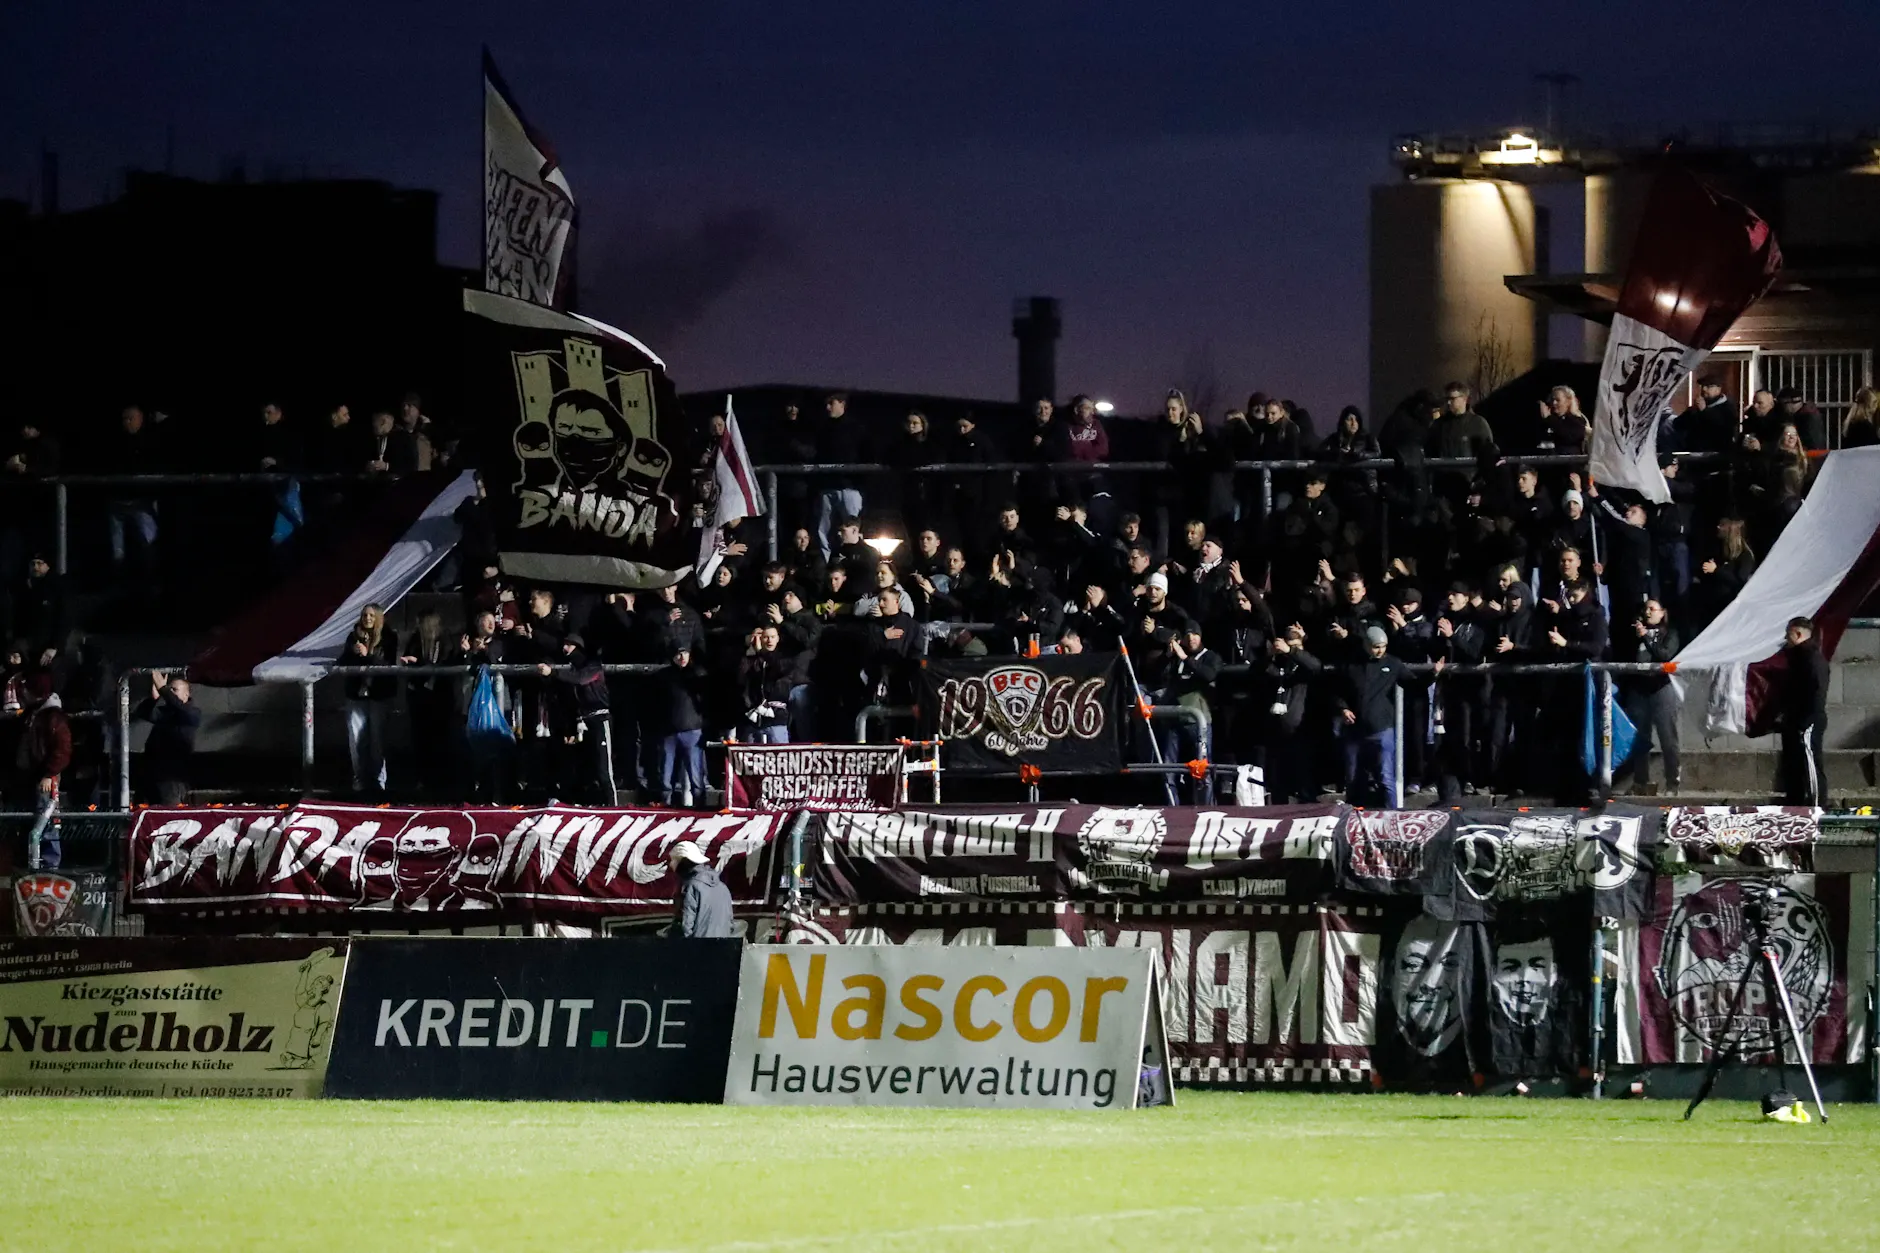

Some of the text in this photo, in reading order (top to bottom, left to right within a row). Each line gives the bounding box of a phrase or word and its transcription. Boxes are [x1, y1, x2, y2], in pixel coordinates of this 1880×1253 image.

[517, 489, 657, 548] BANDA
[992, 672, 1039, 692] BFC
[986, 731, 1047, 754] 60 Jahre
[733, 750, 898, 775] VERBANDSSTRAFEN
[761, 775, 868, 799] ABSCHAFFEN
[135, 811, 773, 891] BANDA INVICTA
[823, 809, 1067, 864] FRAKTION-H
[1185, 811, 1283, 870] OST
[920, 873, 1040, 896] BERLINER FUSSBALL
[1203, 876, 1287, 898] CLUB DYNAMO
[54, 949, 79, 961] Fuß
[103, 959, 133, 970] Berlin
[62, 981, 223, 1006] Kiezgaststätte
[758, 953, 1129, 1043] Nascor
[114, 1009, 137, 1017] zum
[374, 998, 692, 1049] KREDIT.DE
[1, 1011, 275, 1053] Nudelholz
[29, 1058, 234, 1072] Hausgemachte deutsche Küche
[172, 1086, 197, 1098] Tel.
[200, 1087, 226, 1098] 030
[276, 1087, 294, 1098] 07
[751, 1053, 1117, 1108] Hausverwaltung
